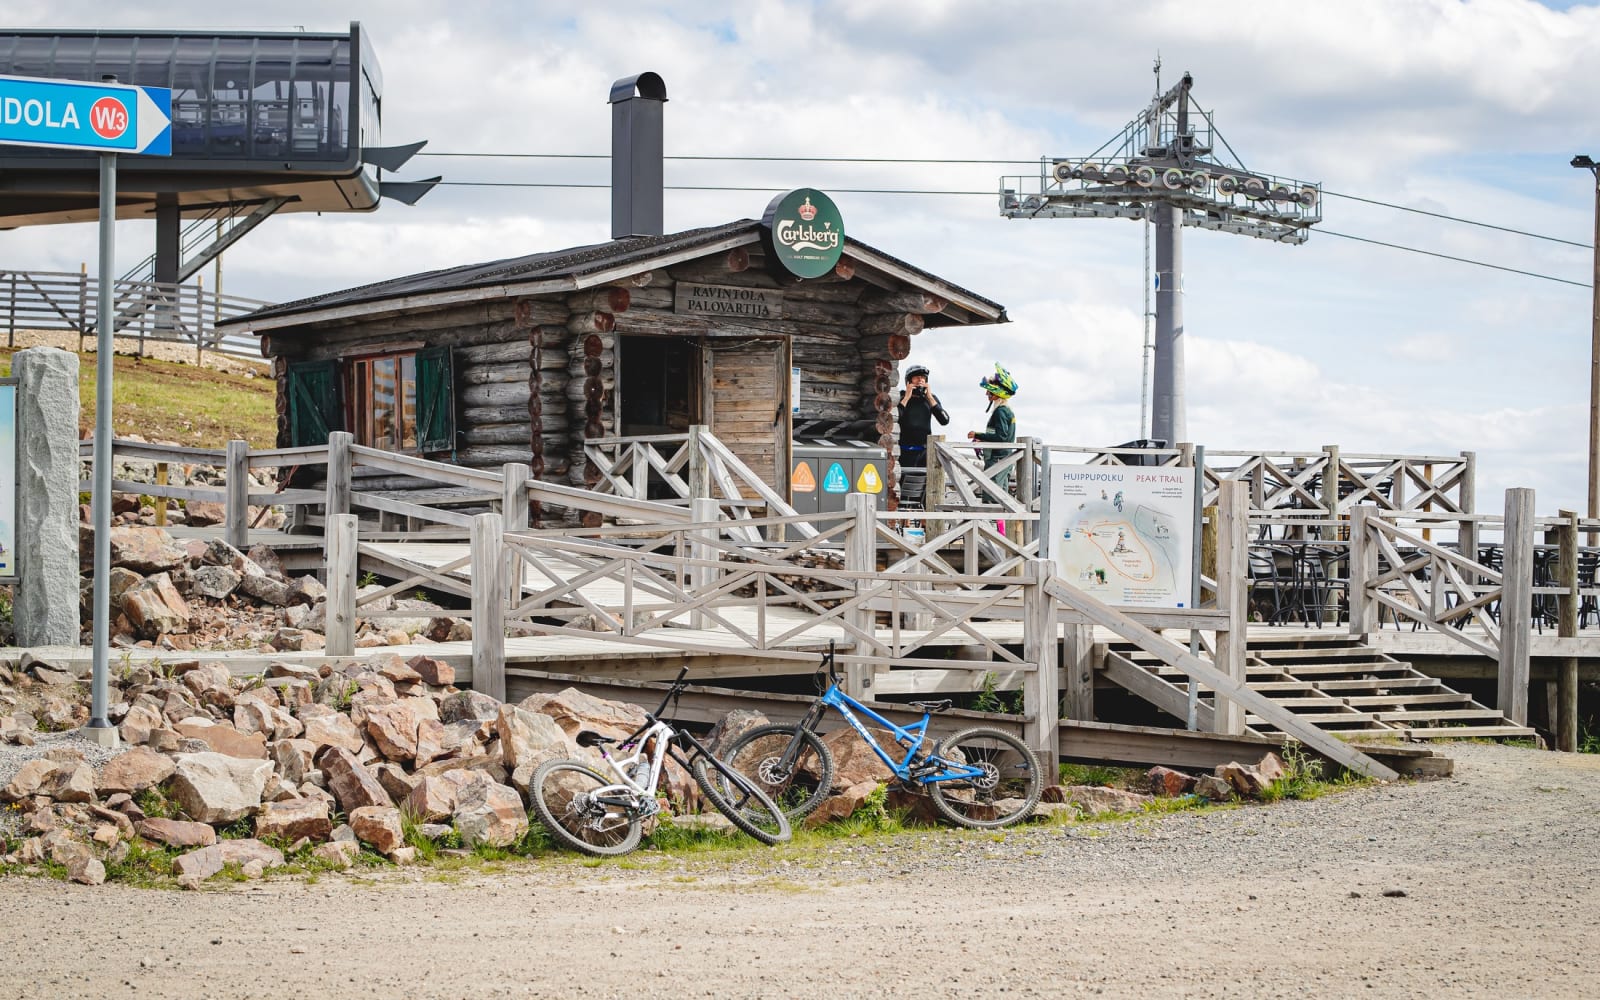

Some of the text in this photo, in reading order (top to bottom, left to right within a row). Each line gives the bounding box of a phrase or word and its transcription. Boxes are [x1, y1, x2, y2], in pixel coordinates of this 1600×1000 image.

[0, 97, 80, 129] DOLA
[777, 219, 839, 252] Carlsberg
[692, 286, 765, 301] RAVINTOLA
[687, 299, 770, 316] PALOVARTIJA
[1063, 472, 1184, 484] HUIPPUPOLKU PEAK TRAIL
